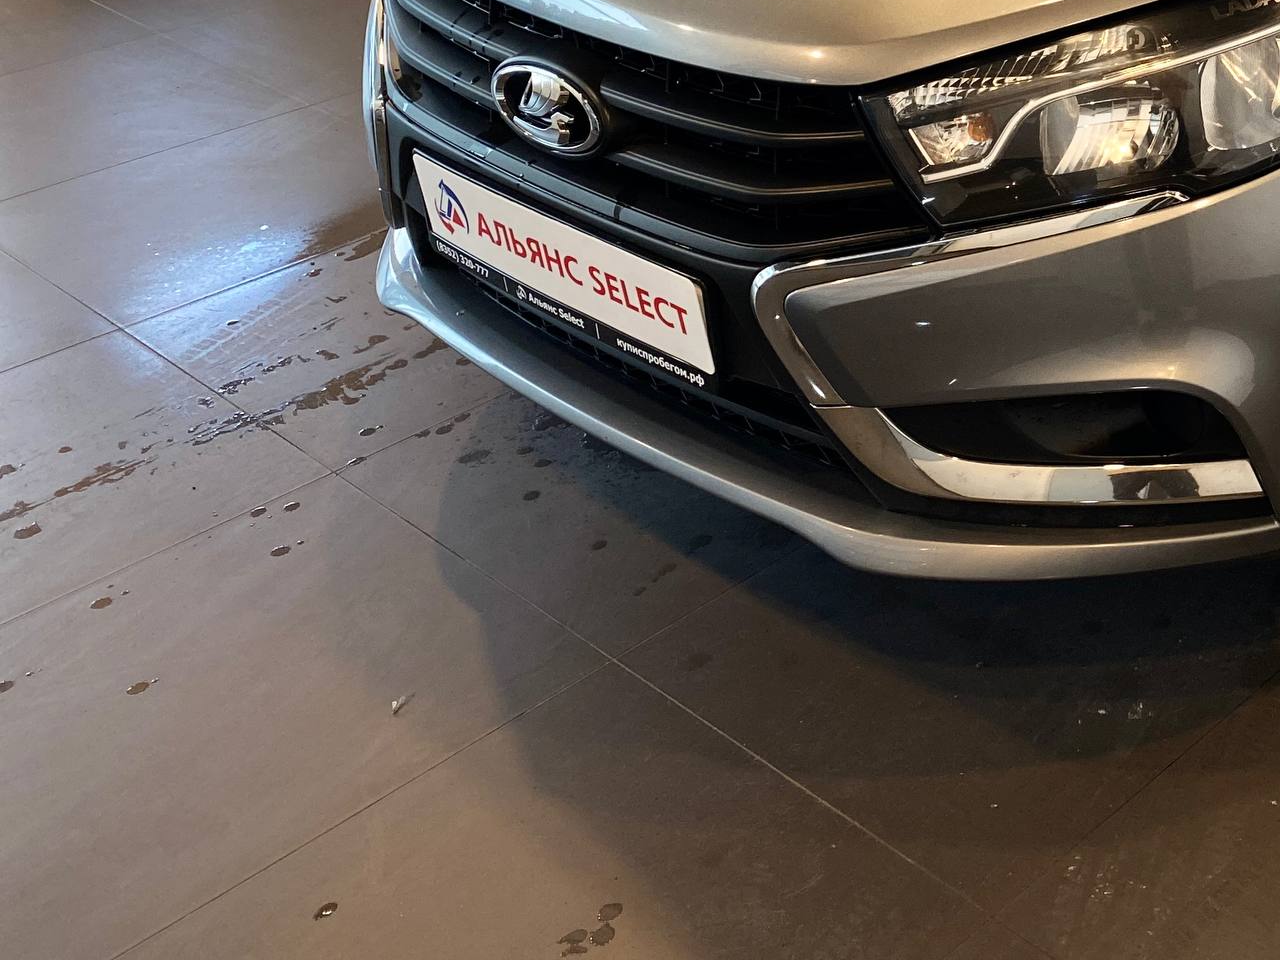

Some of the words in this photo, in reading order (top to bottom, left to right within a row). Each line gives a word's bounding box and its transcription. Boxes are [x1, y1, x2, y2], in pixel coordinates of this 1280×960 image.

[459, 254, 489, 278] 320-777
[477, 212, 583, 286] АЛЬЯНС
[588, 265, 688, 335] SELECT
[528, 293, 558, 316] Альянс
[558, 308, 585, 329] Select
[616, 338, 705, 387] куписпробегом.рф
